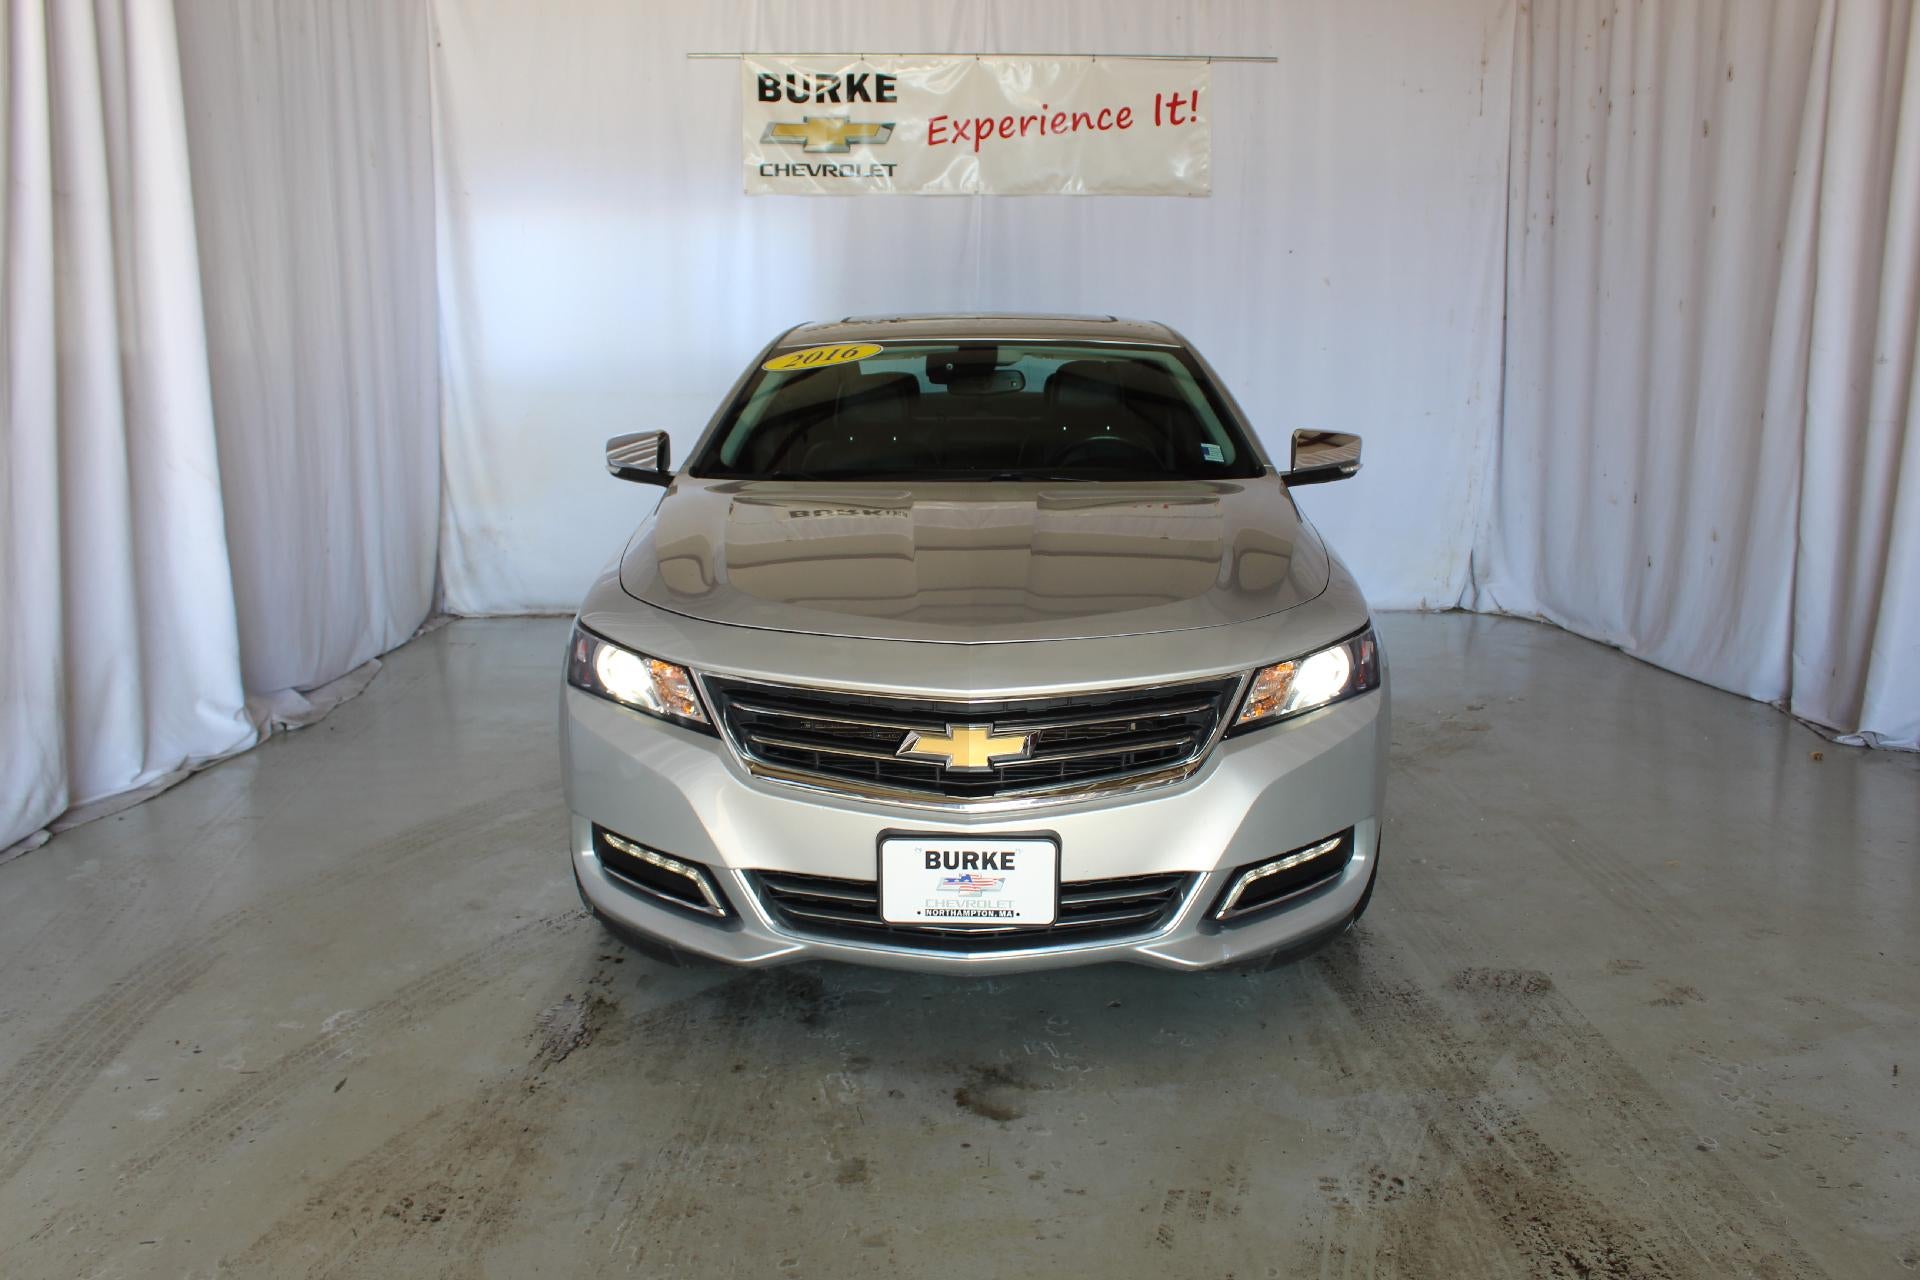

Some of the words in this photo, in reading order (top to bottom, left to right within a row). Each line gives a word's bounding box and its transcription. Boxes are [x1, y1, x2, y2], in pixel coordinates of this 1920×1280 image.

[757, 73, 898, 103] BURKE
[926, 104, 1134, 152] Experience
[1154, 90, 1200, 127] It!
[760, 163, 898, 178] CHEVROLET
[783, 347, 860, 368] 2016
[925, 850, 1016, 870] BURKE
[925, 899, 1013, 909] CHEVROLET
[998, 909, 1014, 917] MA
